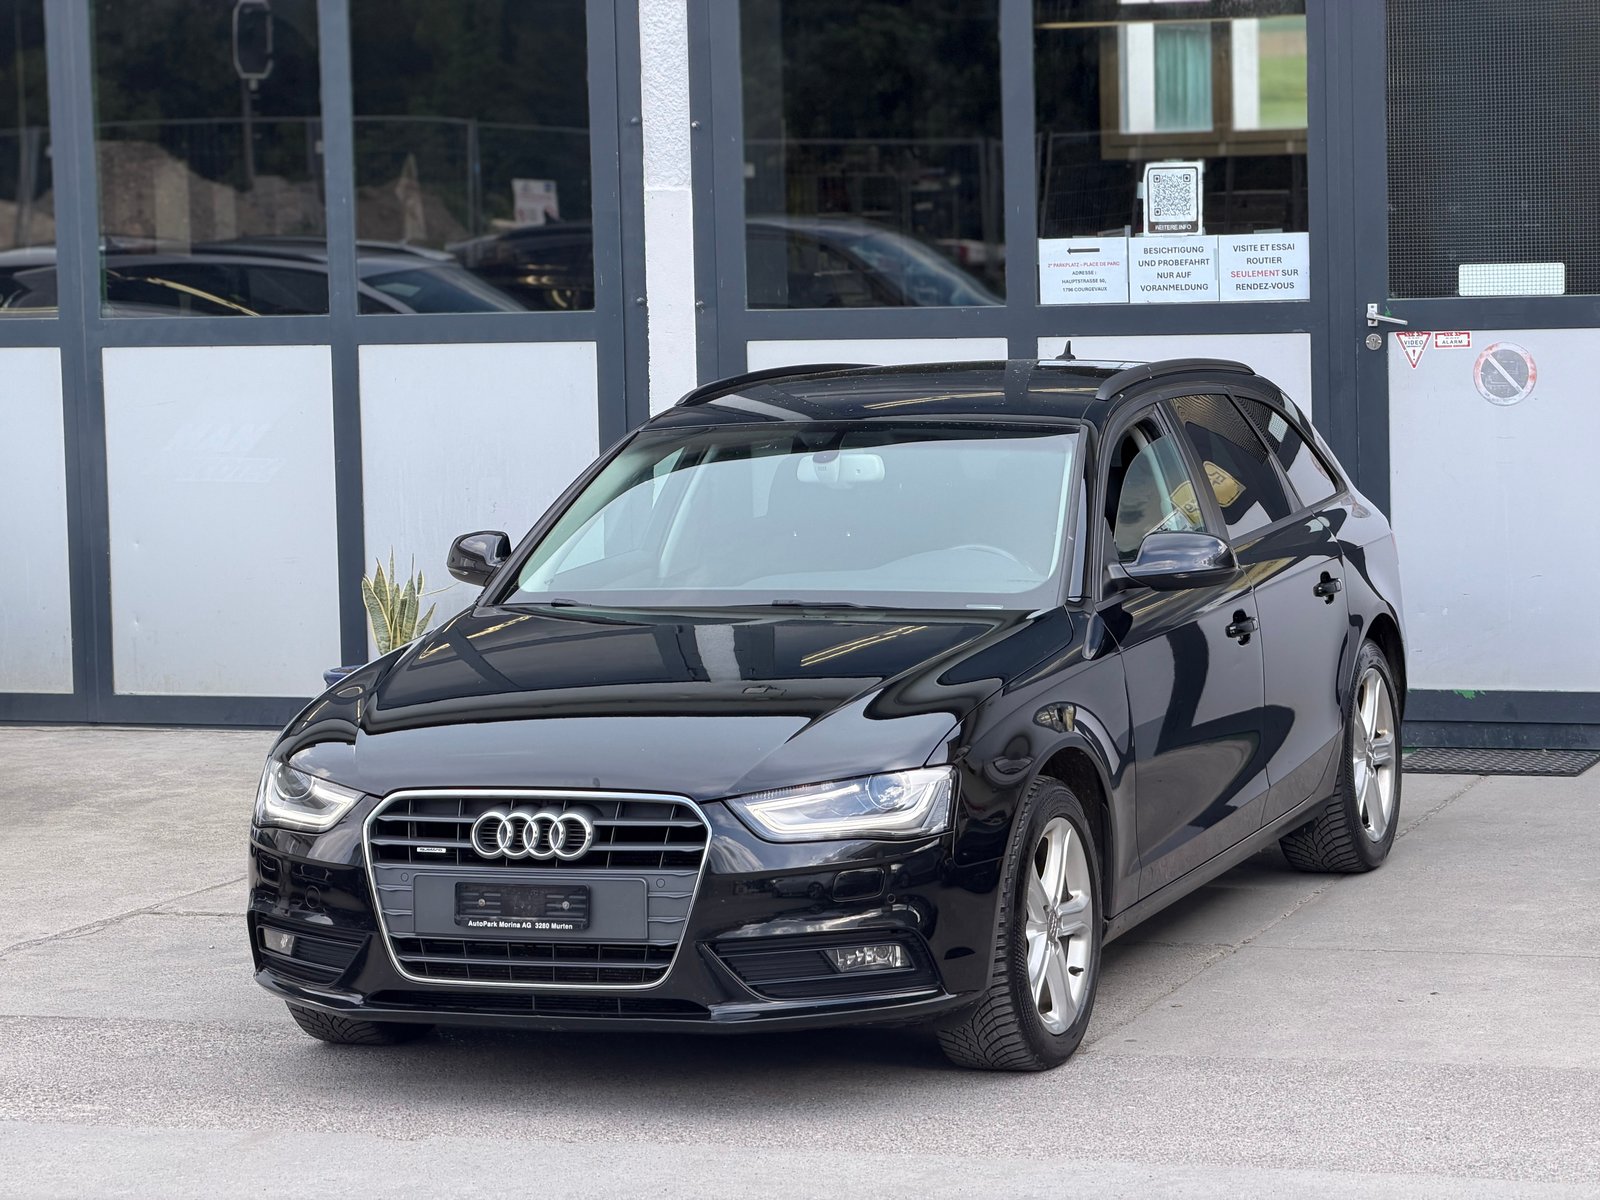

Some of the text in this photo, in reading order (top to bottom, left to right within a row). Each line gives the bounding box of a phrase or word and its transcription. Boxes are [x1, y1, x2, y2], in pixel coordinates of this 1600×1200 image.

[1143, 246, 1204, 254] BESICHTIGUNG
[1232, 244, 1258, 252] VISITE
[1271, 243, 1295, 251] ESSAI
[1138, 258, 1210, 267] UND PROBEFAHRT
[1246, 256, 1282, 265] ROUTIER
[1156, 271, 1175, 279] NUR
[1231, 268, 1299, 278] SEULEMENT SUR
[1140, 283, 1209, 292] VORANMELDUNG
[1235, 281, 1295, 291] RENDEZ-VOUS
[468, 919, 498, 928] AutoPark
[498, 921, 521, 929] Morina
[534, 922, 550, 930] 3280
[550, 922, 573, 930] Murten
